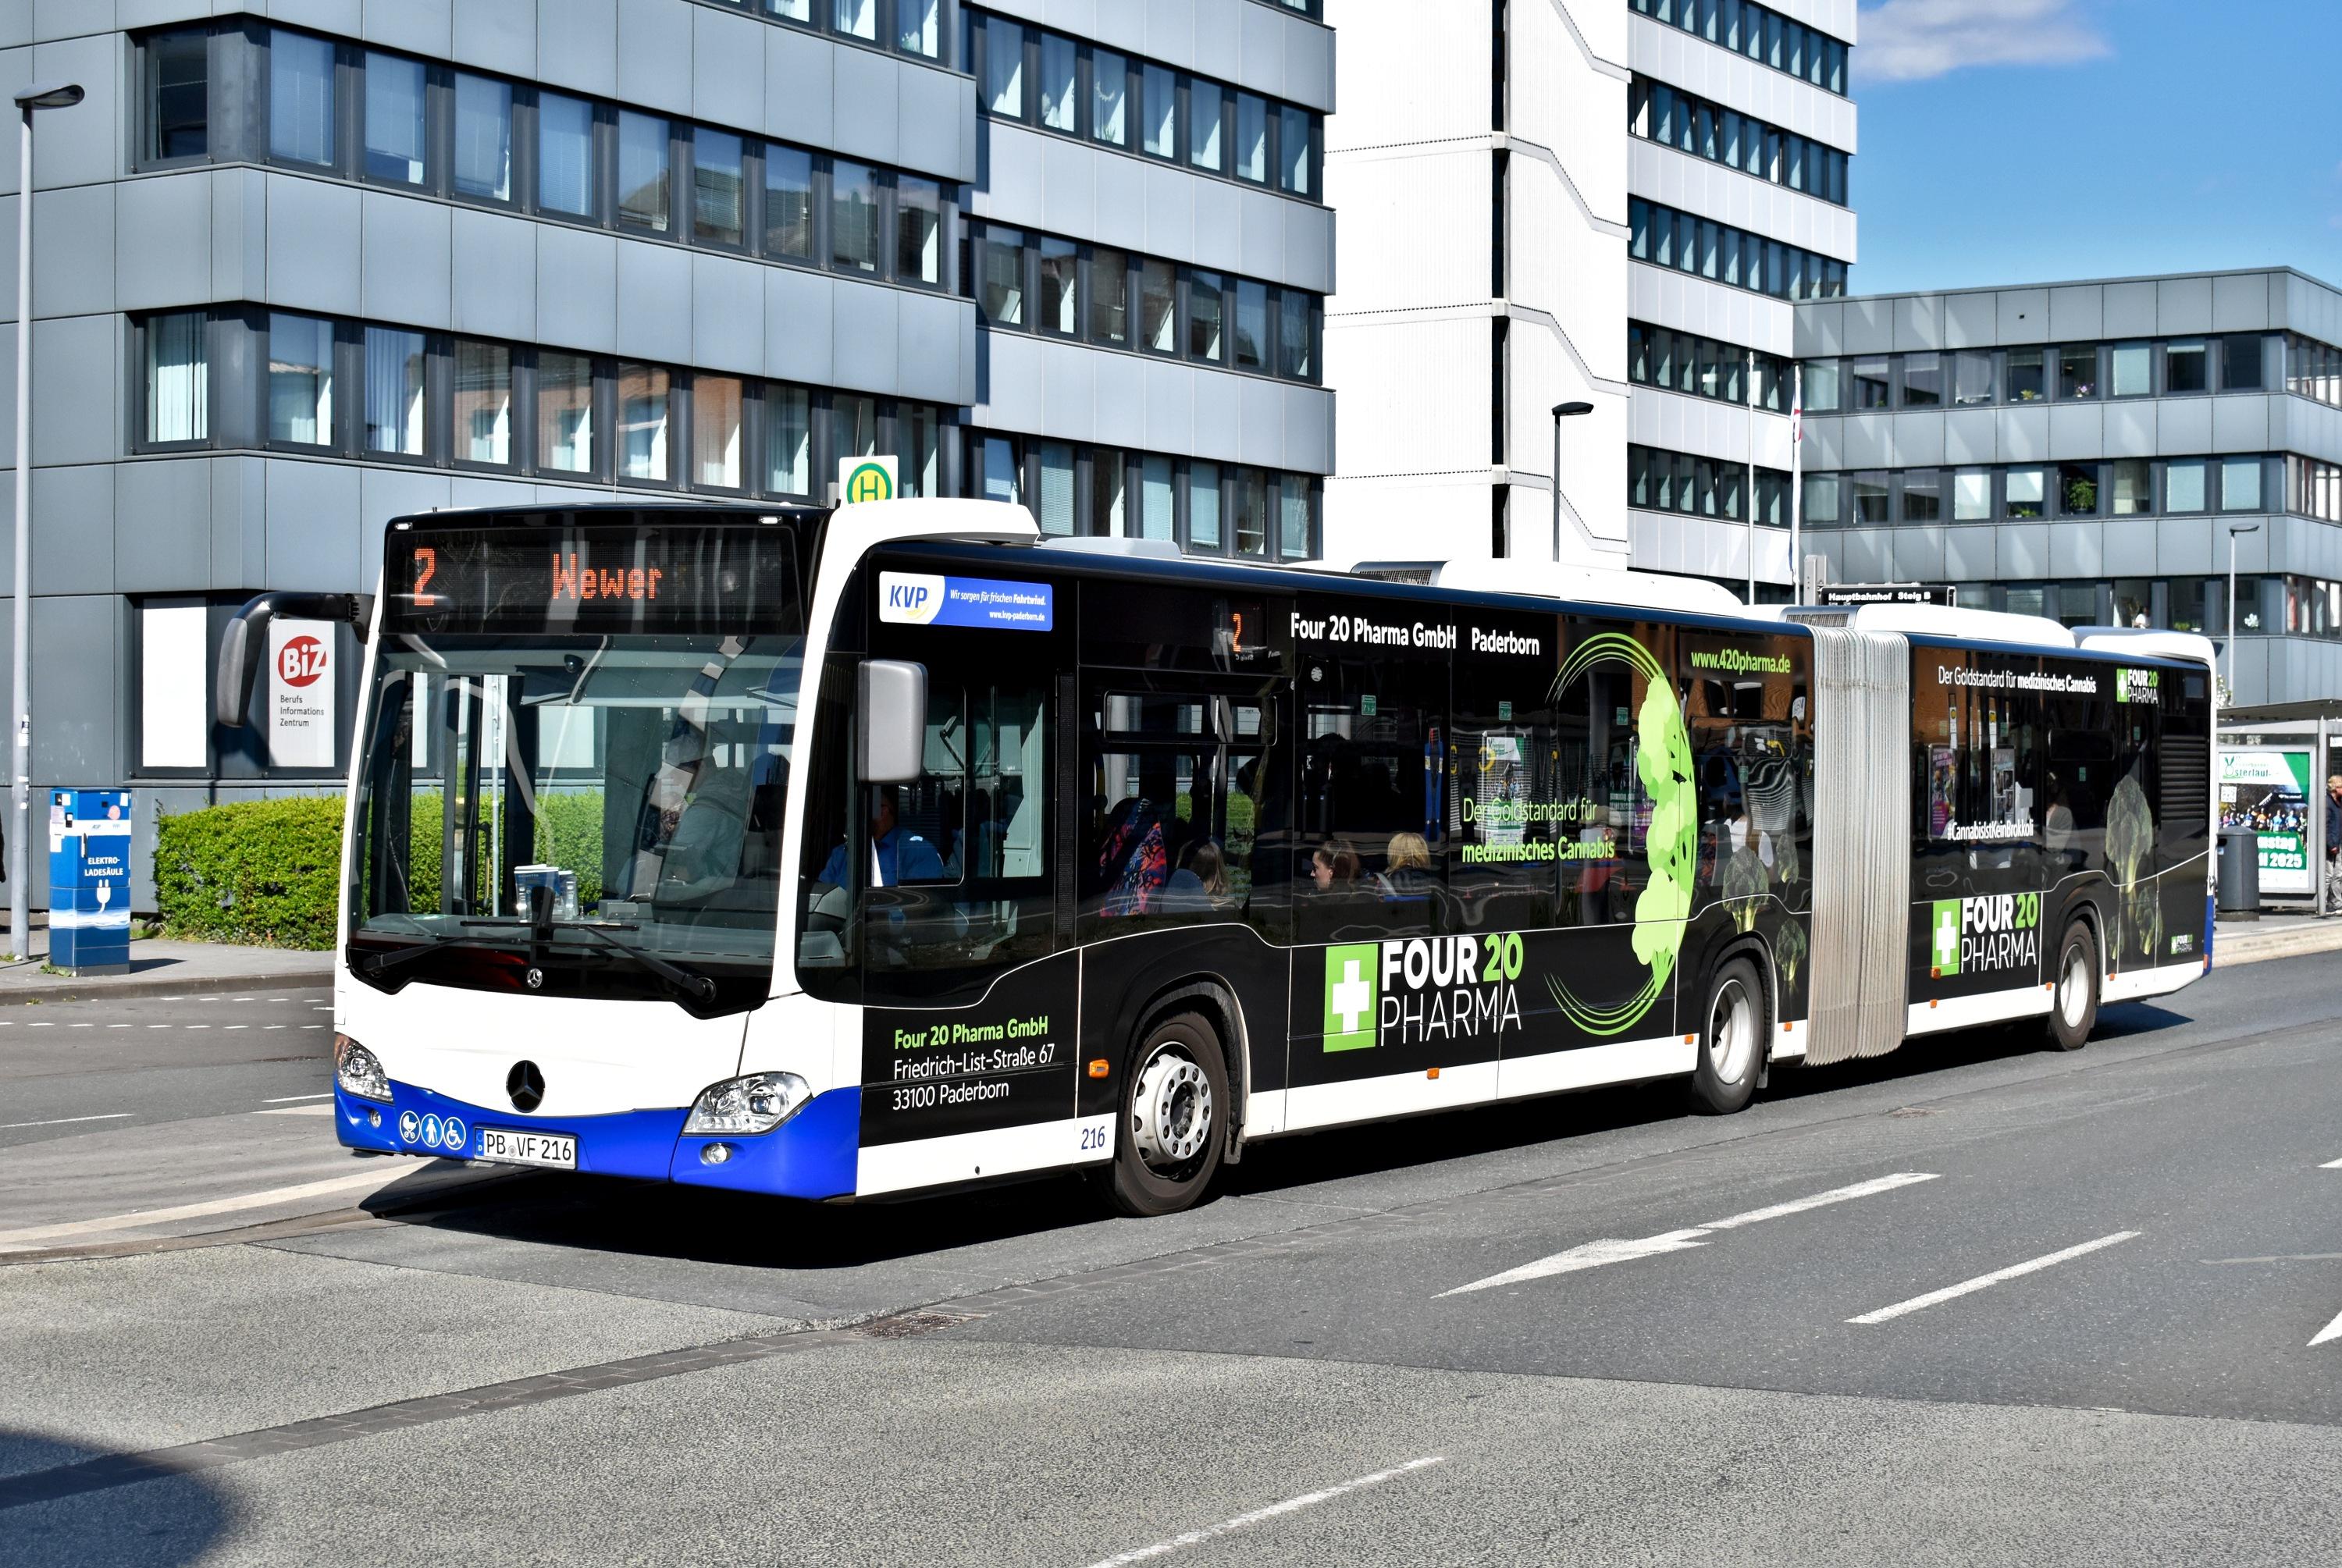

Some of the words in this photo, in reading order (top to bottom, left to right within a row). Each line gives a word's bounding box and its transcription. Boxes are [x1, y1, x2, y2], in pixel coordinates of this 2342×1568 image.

[860, 475, 878, 503] H
[414, 548, 435, 606] 2
[553, 553, 662, 599] Wewer
[889, 585, 928, 609] KVP
[950, 589, 959, 599] Wir
[960, 592, 980, 603] sorgen
[981, 591, 991, 603] für
[989, 592, 1013, 604] frischen
[1013, 593, 1046, 606] Fahrtwind.
[1828, 592, 1892, 603] Hauptbahnhof
[1897, 592, 1922, 602] Steig
[1924, 592, 1931, 600] B
[989, 610, 1045, 622] www.kvp-paderborn.de
[1233, 613, 1241, 652] 2
[1290, 612, 1326, 640] Four
[1329, 615, 1350, 642] 20
[1354, 617, 1408, 646] Pharma
[1412, 622, 1457, 649] GmbH
[1472, 627, 1540, 656] Paderborn
[283, 643, 327, 680] BiZ
[1691, 649, 1791, 676] www.420pharma.de
[1938, 665, 1952, 684] Der
[1954, 667, 2005, 688] Goldstandard
[2006, 670, 2016, 688] für
[2017, 672, 2066, 692] medizinisches
[2066, 674, 2097, 694] Cannabis
[2127, 669, 2148, 687] FOUR
[2148, 670, 2158, 688] 20
[280, 695, 303, 703] Berufs
[2127, 687, 2159, 704] PHARMA
[279, 718, 309, 727] Zentrum
[280, 707, 324, 716] Informations
[1463, 798, 1486, 823] Der
[1492, 797, 1577, 821] Goldstandard
[1581, 797, 1597, 821] für
[1947, 819, 2034, 841] #CannabisIstKeinBrokkoli
[1462, 837, 1555, 863] medizinisches
[1557, 836, 1615, 860] Cannabis
[2257, 836, 2297, 852] mstag
[84, 867, 123, 876] LADESÄULE
[87, 856, 120, 865] ELEKTRO-
[2269, 852, 2303, 868] 2025
[1962, 894, 2013, 935] FOUR
[2015, 892, 2038, 929] 20
[1382, 935, 1479, 992] FOUR
[1483, 932, 1524, 982] 20
[1960, 930, 2037, 974] PHARMA
[1380, 983, 1522, 1047] PHARMA
[895, 1029, 927, 1050] Four
[930, 1025, 949, 1047] 20
[952, 1021, 1004, 1044] Pharma
[1007, 1015, 1048, 1039] GmbH
[894, 1046, 1036, 1080] Friedrich-List-Straße
[1039, 1043, 1055, 1064] 67
[892, 1085, 935, 1111] 33100
[940, 1080, 1009, 1105] Paderborn
[486, 1133, 506, 1155] PB
[517, 1136, 536, 1157] VF
[541, 1140, 571, 1161] 216
[1080, 1125, 1105, 1150] 216
